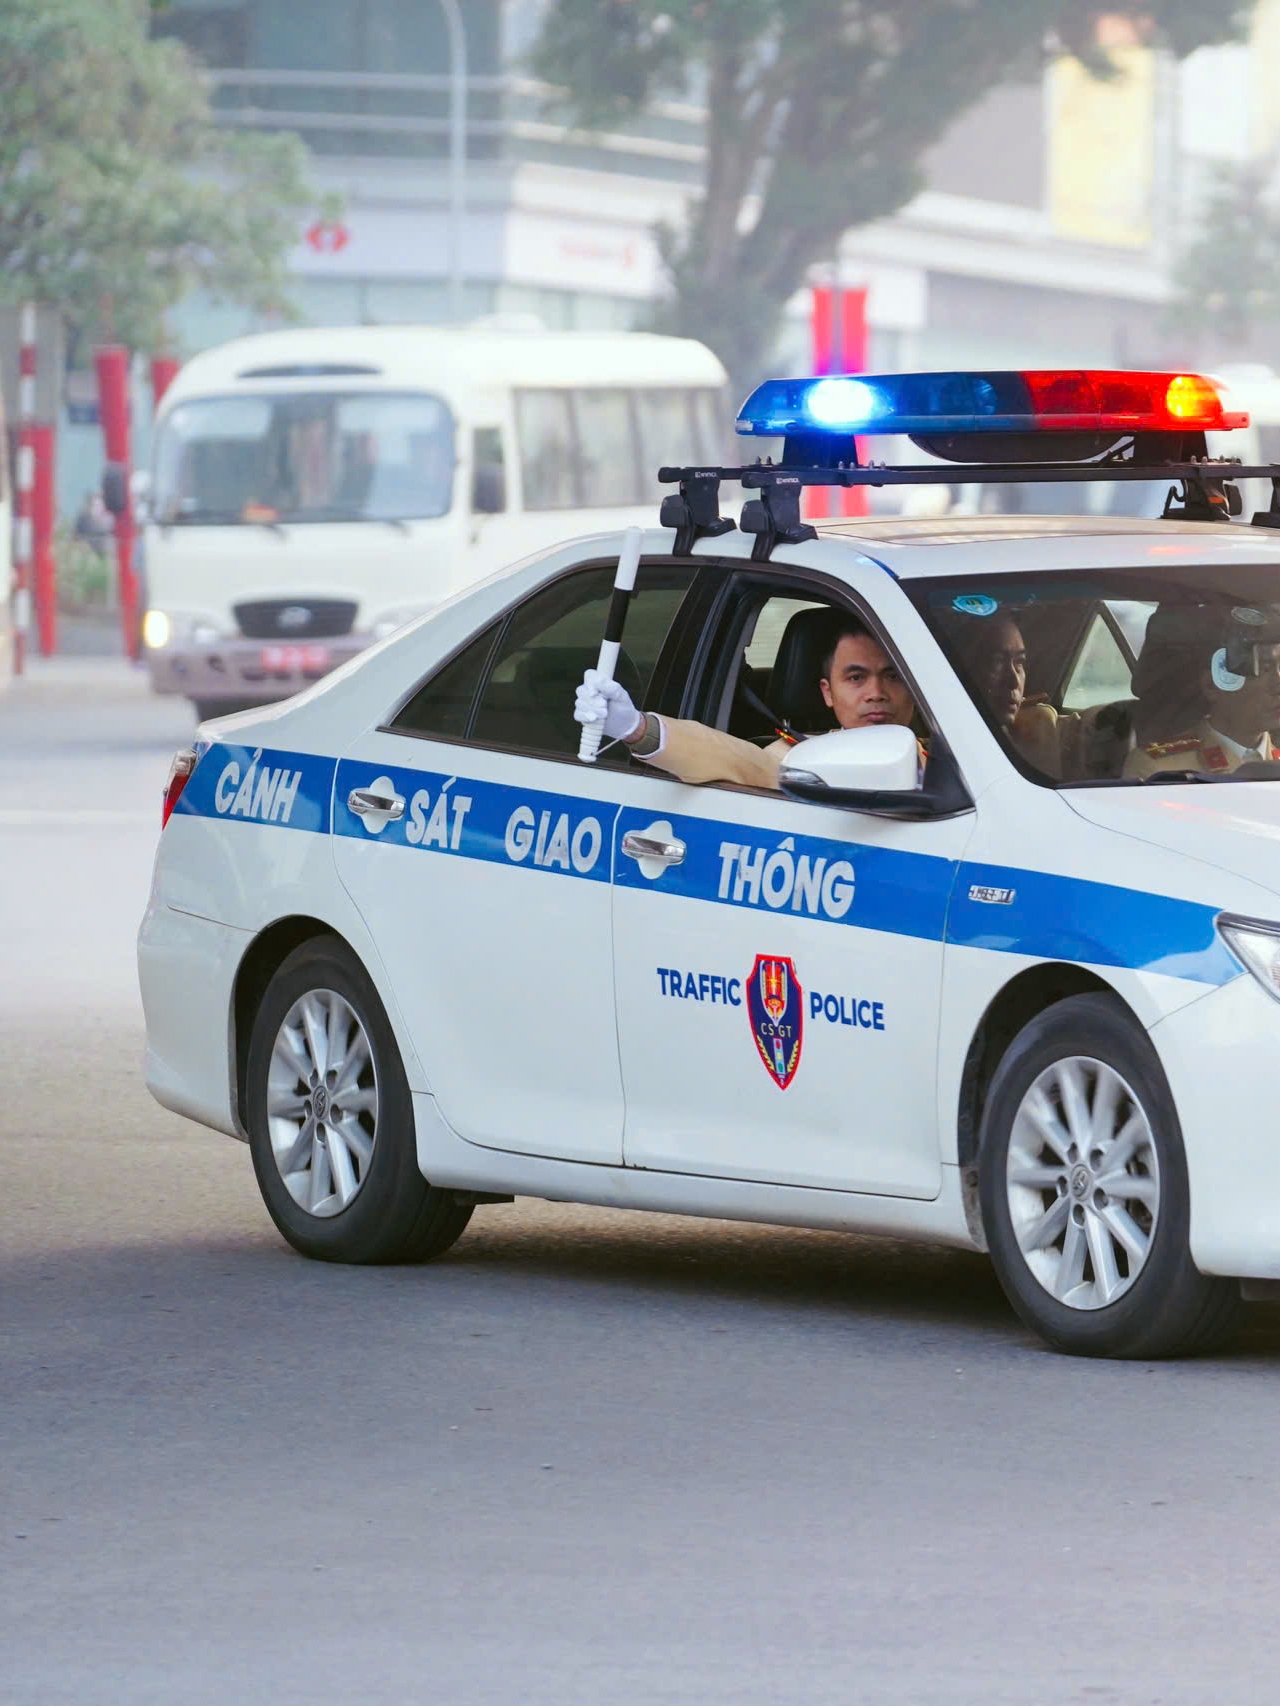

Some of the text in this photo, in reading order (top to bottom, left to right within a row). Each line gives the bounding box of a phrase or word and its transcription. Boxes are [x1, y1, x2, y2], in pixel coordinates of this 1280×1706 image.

[405, 775, 472, 850] SÁT
[505, 805, 601, 873] GIAO
[718, 837, 856, 919] THÔNG
[656, 967, 885, 1031] TRAFFIC POLICE
